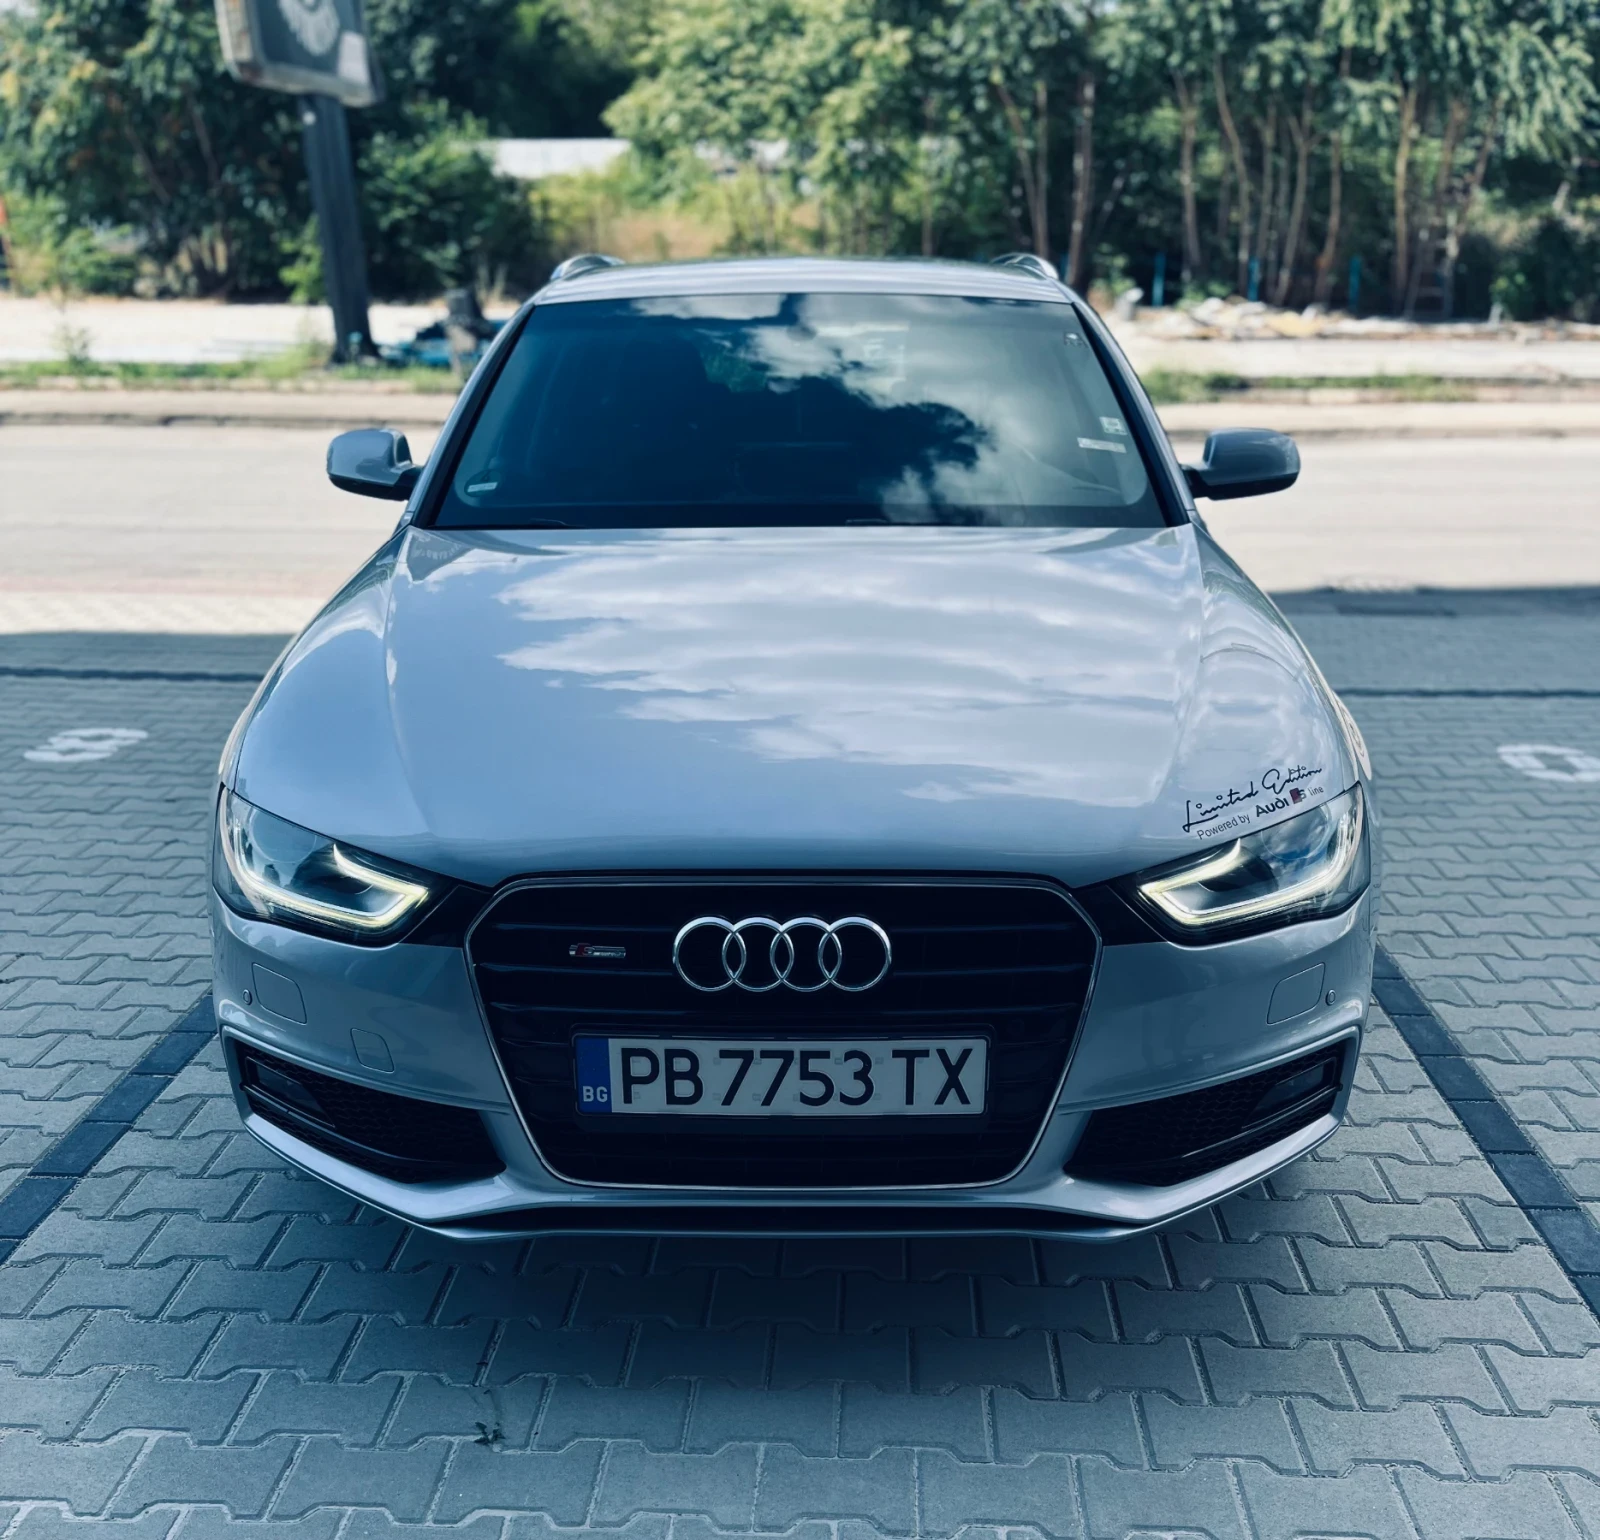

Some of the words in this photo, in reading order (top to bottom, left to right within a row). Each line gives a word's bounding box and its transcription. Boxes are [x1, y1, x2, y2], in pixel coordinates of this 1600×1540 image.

[1182, 781, 1259, 833] Limited
[1261, 765, 1323, 795] Edition
[1197, 816, 1239, 840] Powered
[1240, 813, 1251, 825] by
[1308, 785, 1325, 797] line
[582, 1085, 609, 1102] BG
[620, 1047, 704, 1106] PB
[718, 1049, 875, 1107] 7753
[891, 1048, 973, 1106] TX
